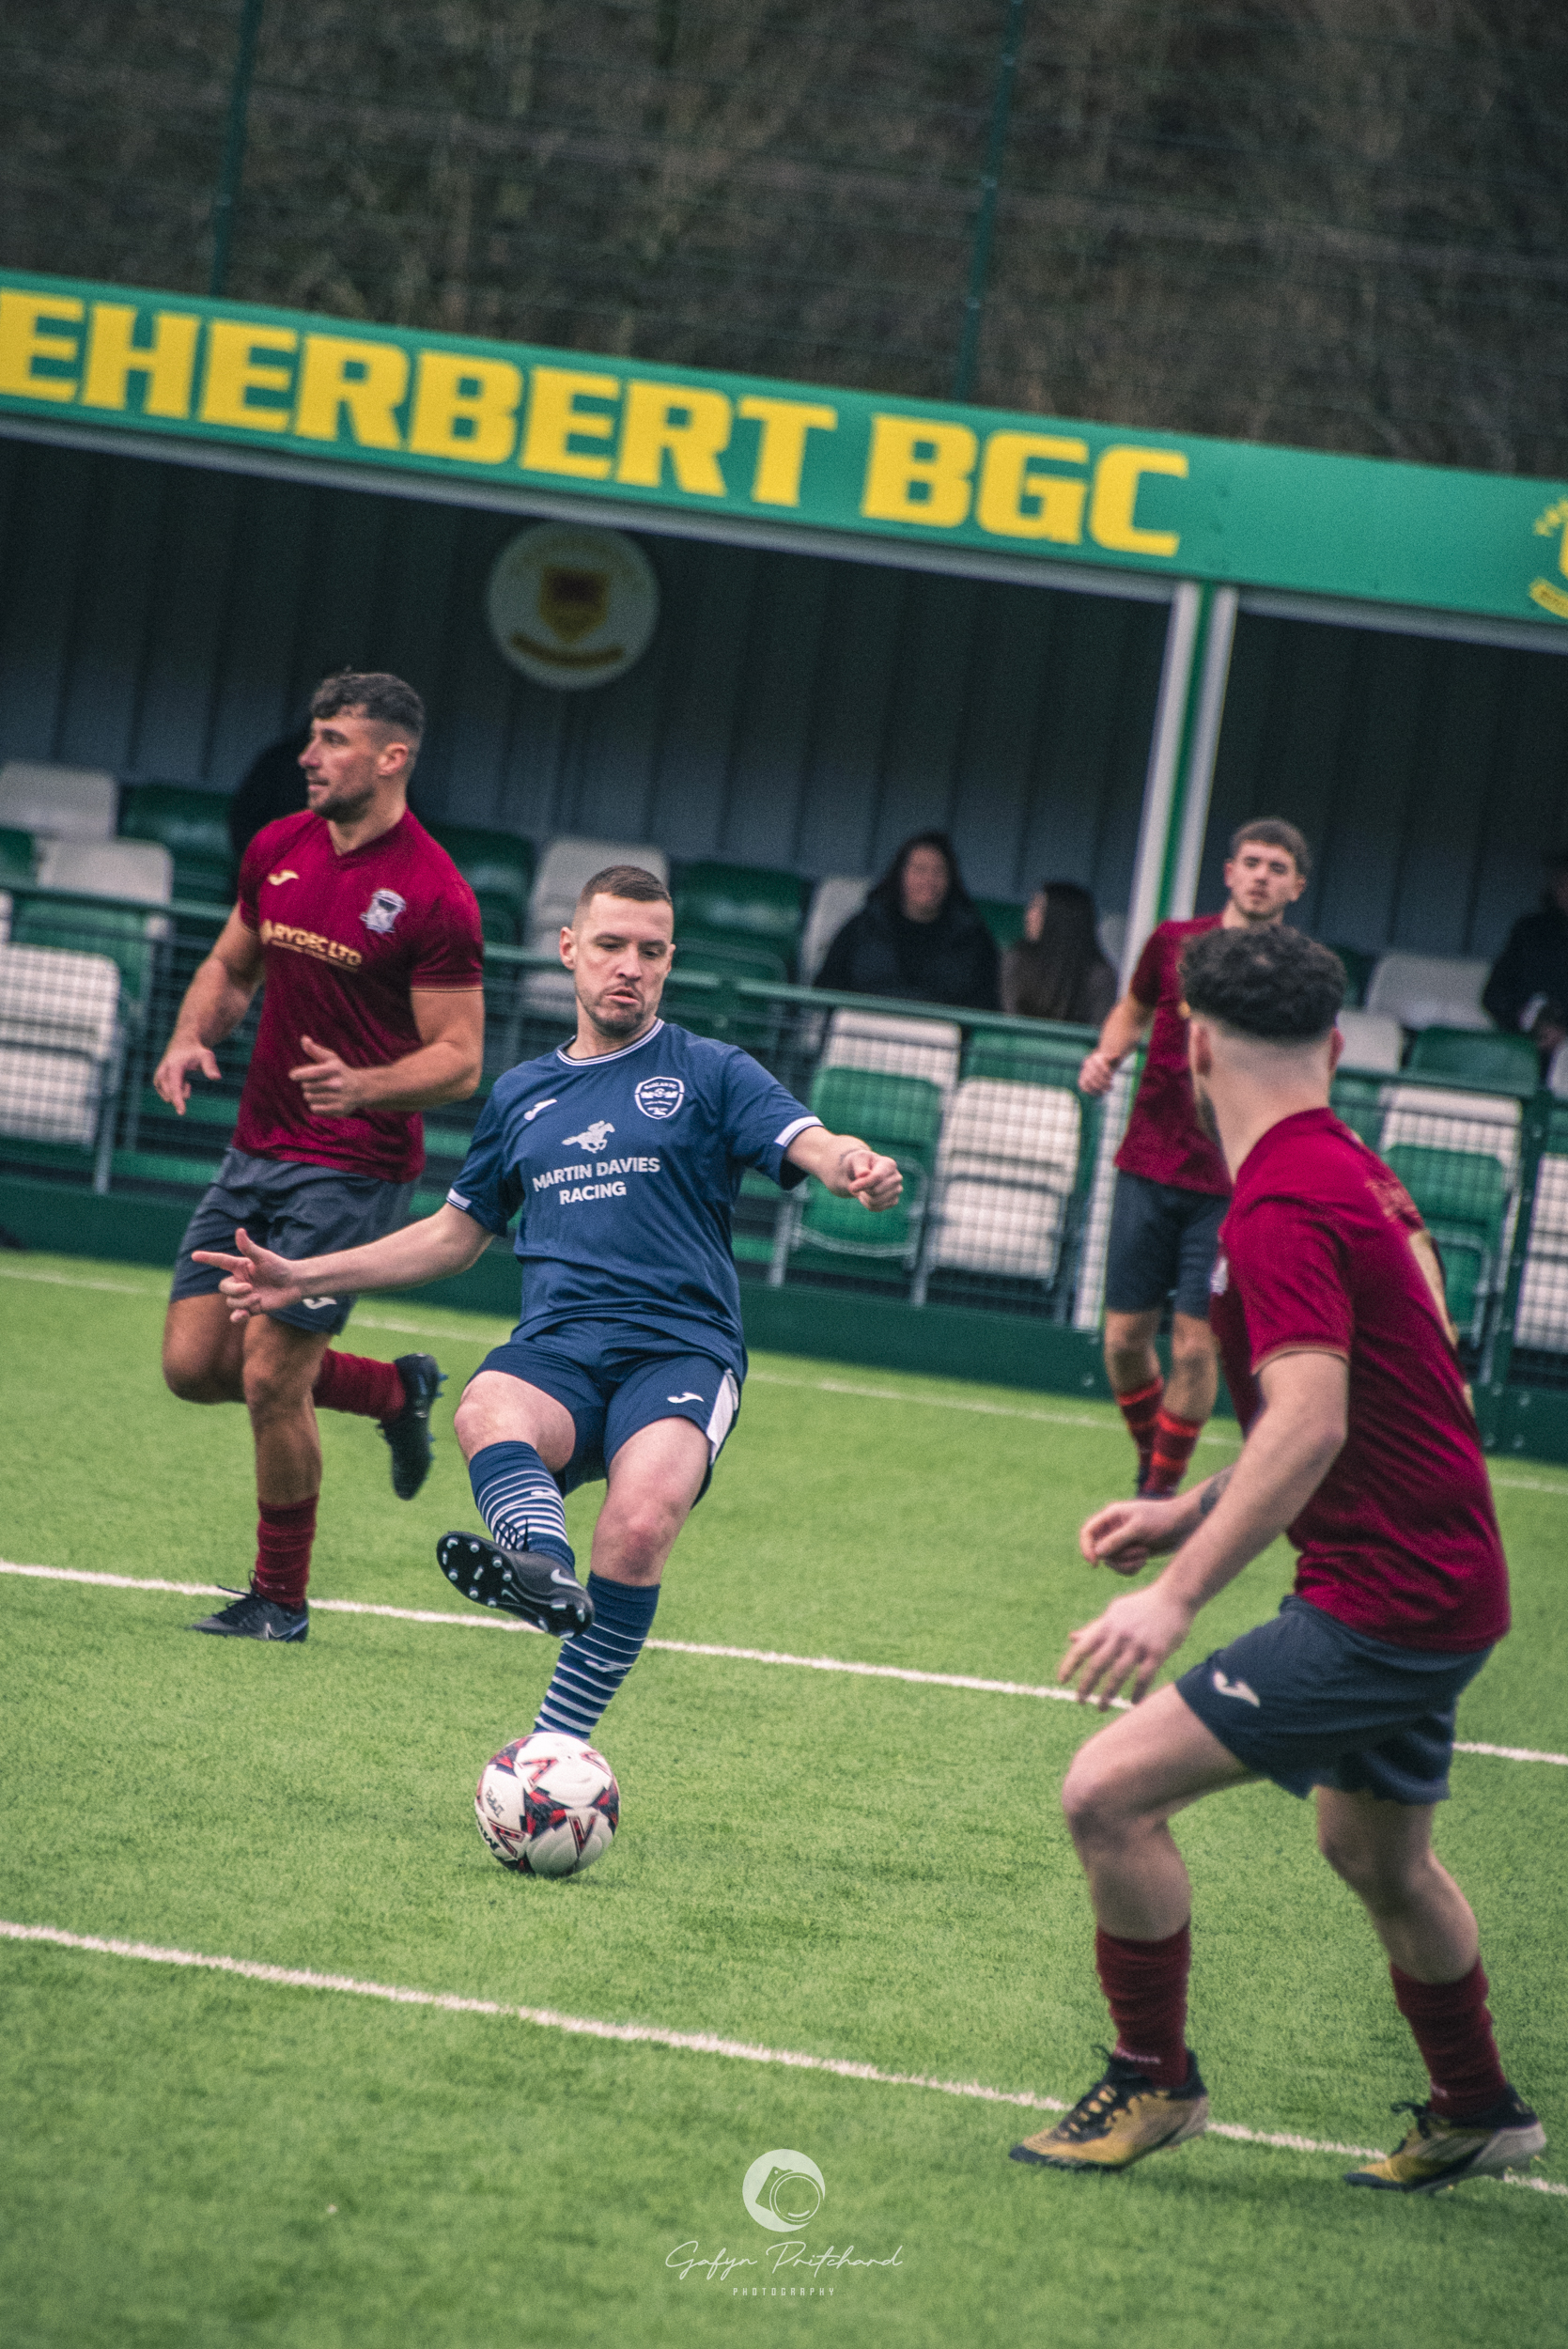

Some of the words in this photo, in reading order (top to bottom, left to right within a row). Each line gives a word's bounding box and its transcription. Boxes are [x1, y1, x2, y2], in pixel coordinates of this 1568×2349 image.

[0, 289, 838, 507] EHERBERT
[862, 413, 1189, 557] BGC
[532, 1163, 593, 1192] MARTIN
[596, 1157, 660, 1176] DAVIES
[559, 1181, 627, 1206] RACING
